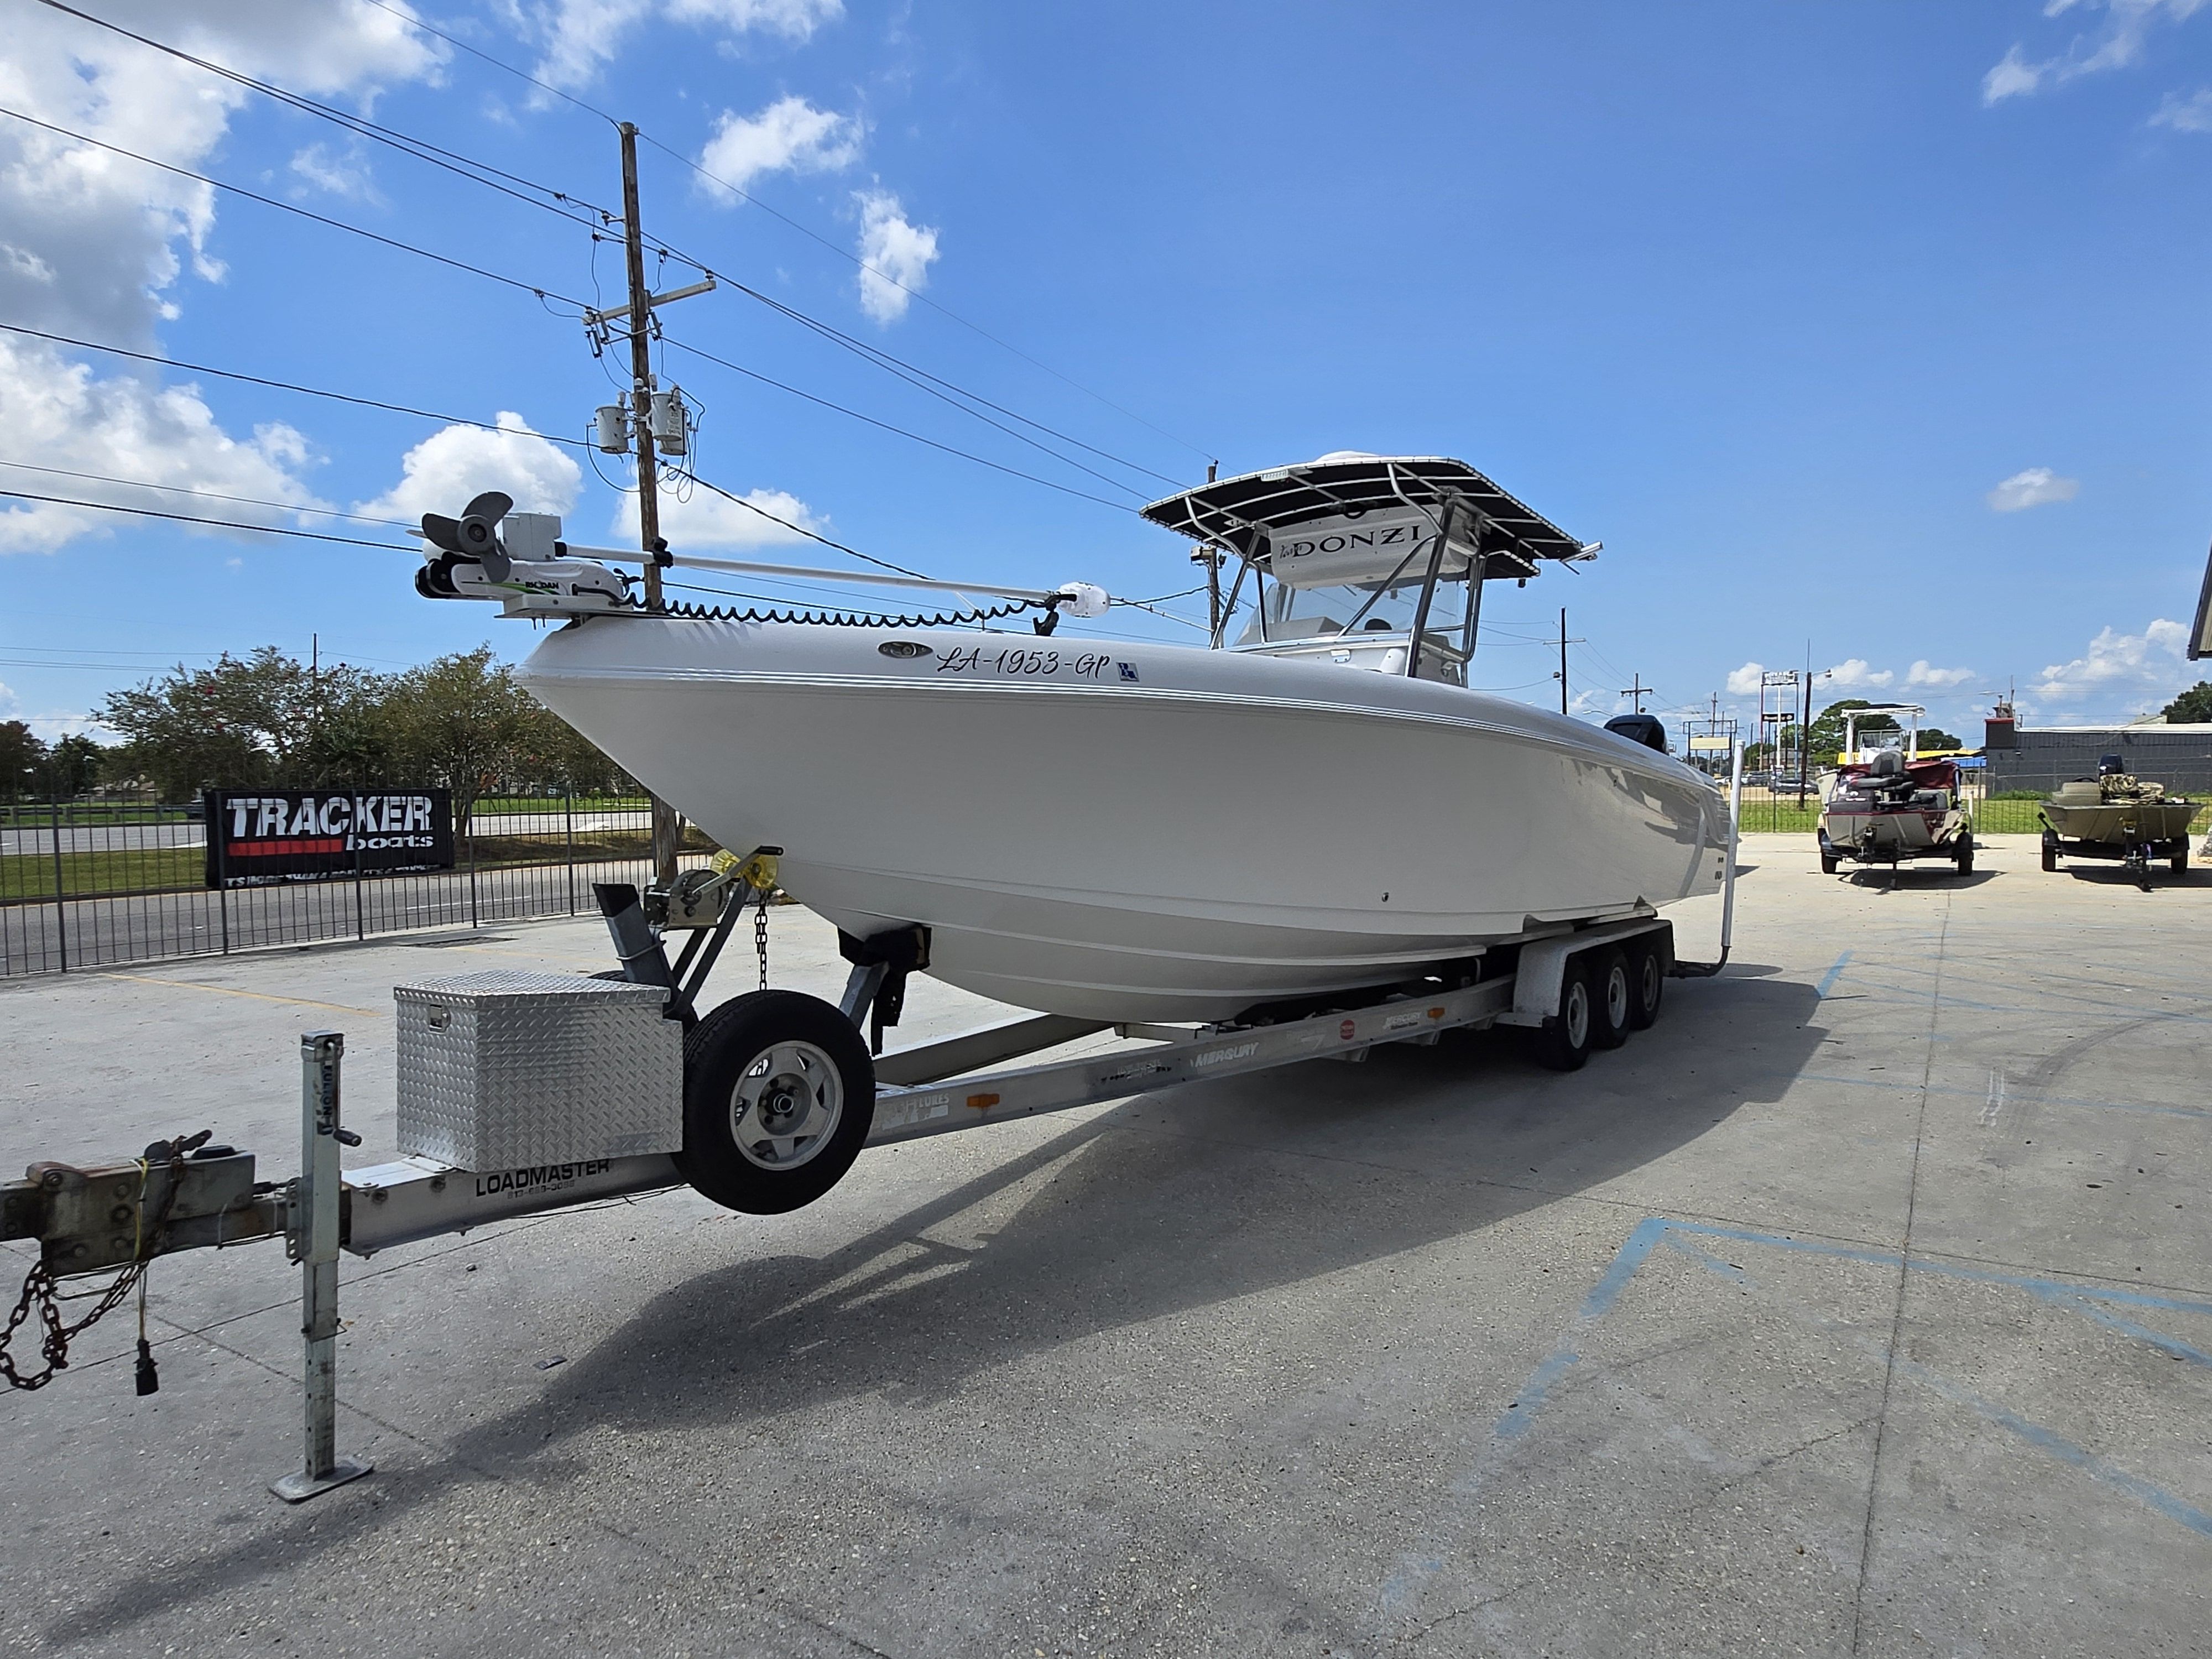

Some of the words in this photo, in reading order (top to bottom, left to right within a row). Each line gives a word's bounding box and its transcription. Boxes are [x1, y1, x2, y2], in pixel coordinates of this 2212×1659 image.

[1292, 525, 1421, 557] DONZI
[937, 646, 1110, 679] LA-1953-GP
[226, 796, 433, 838] TRACKER
[346, 834, 434, 851] boats
[1194, 1041, 1259, 1067] MERCURY
[476, 1158, 610, 1197] LOADMASTER
